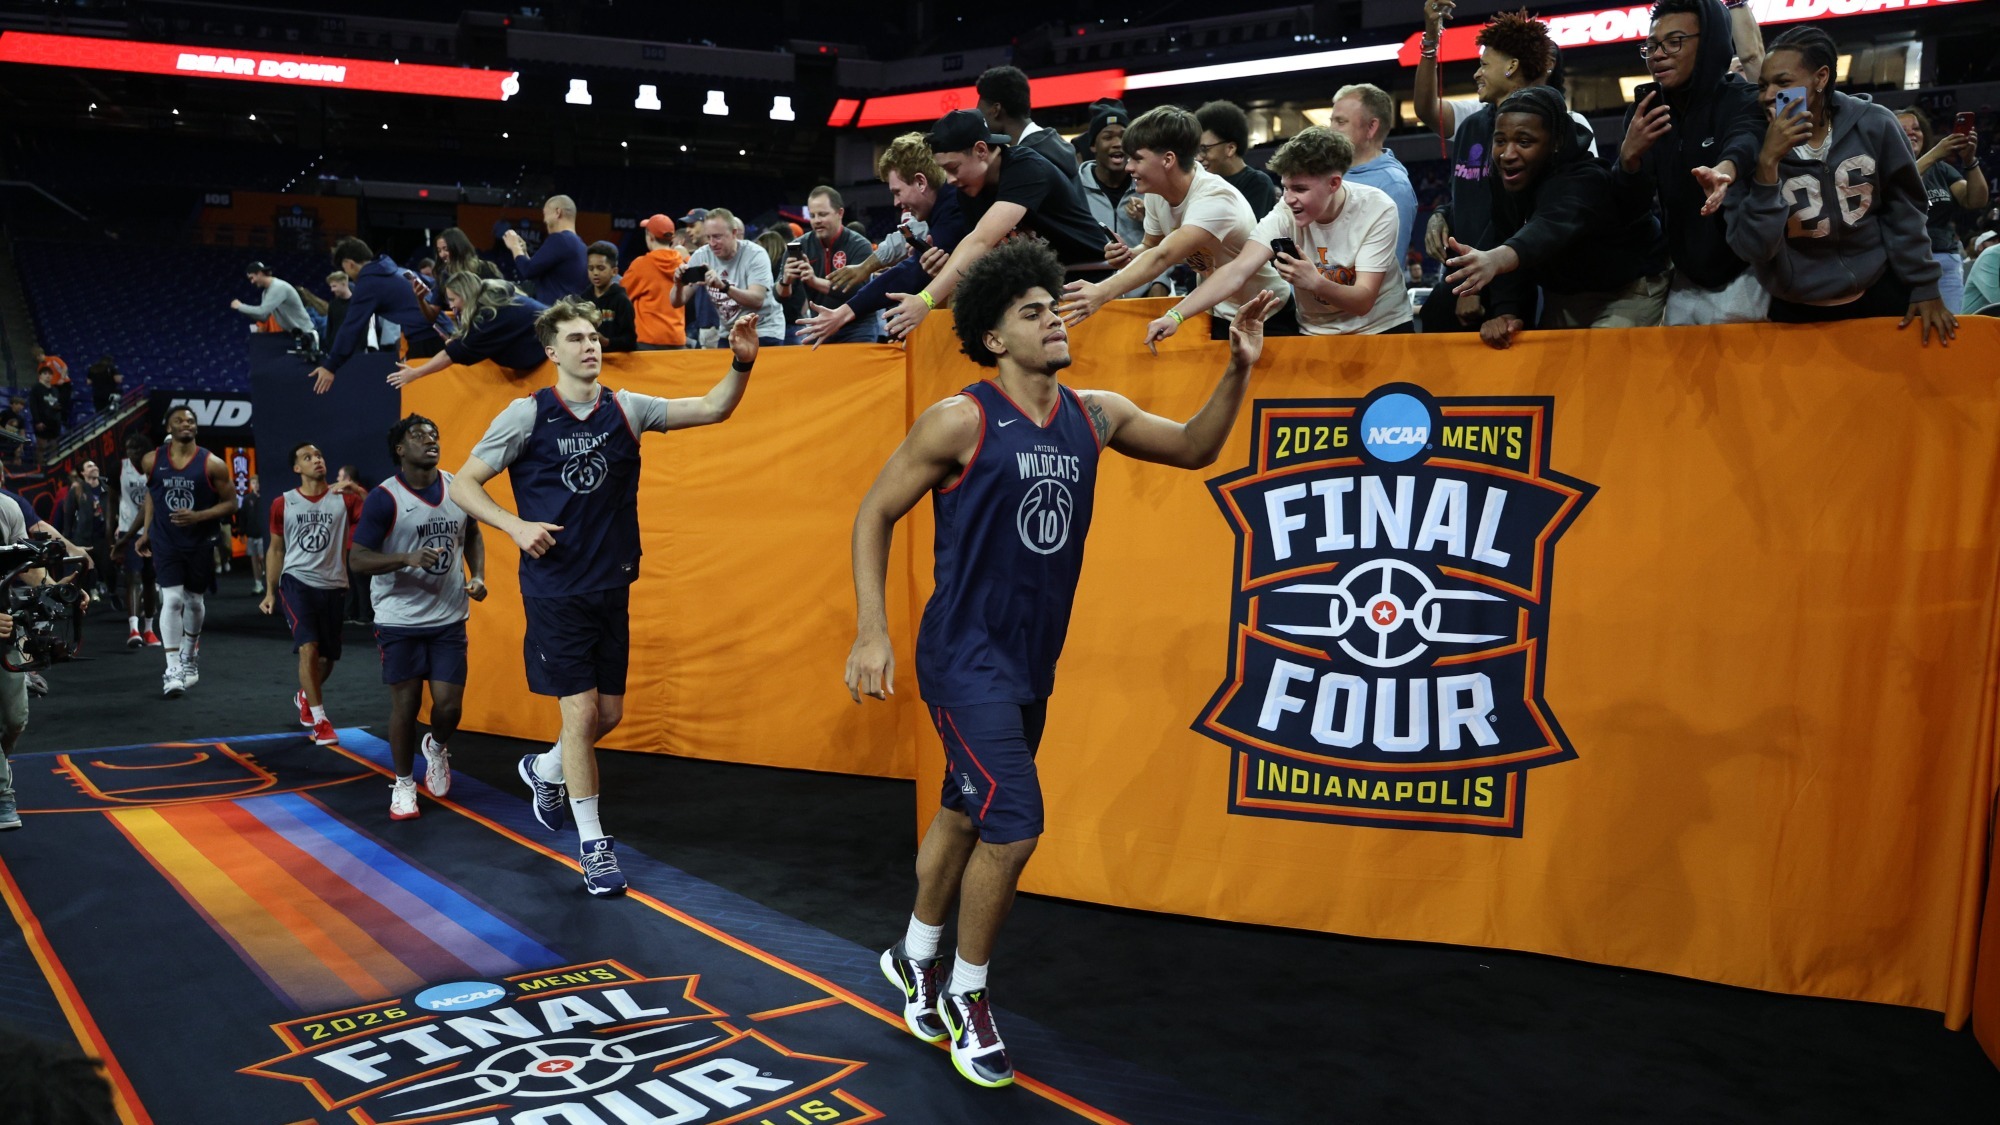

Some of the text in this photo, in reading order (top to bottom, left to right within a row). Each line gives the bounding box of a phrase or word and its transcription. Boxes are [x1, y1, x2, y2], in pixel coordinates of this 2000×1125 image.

[176, 53, 346, 82] BEAR DOWN
[1782, 154, 1876, 239] 26
[557, 432, 609, 456] WILDCATS
[1034, 444, 1059, 453] ARIZONA
[1275, 425, 1522, 460] 2026 NCAA MEN'S
[1016, 452, 1080, 483] WILDCATS
[163, 478, 195, 490] WILDCATS
[173, 497, 188, 510] 30
[296, 513, 333, 525] WILDCATS
[416, 520, 459, 539] WILDCATS
[1037, 509, 1058, 544] 10
[1263, 475, 1511, 568] FINAL
[307, 535, 320, 549] 21
[1257, 658, 1500, 752] FOUR
[1257, 759, 1494, 808] INDIANAPOLIS
[304, 968, 617, 1041] 2026 NCAA MEN'S
[313, 988, 670, 1084] FINAL
